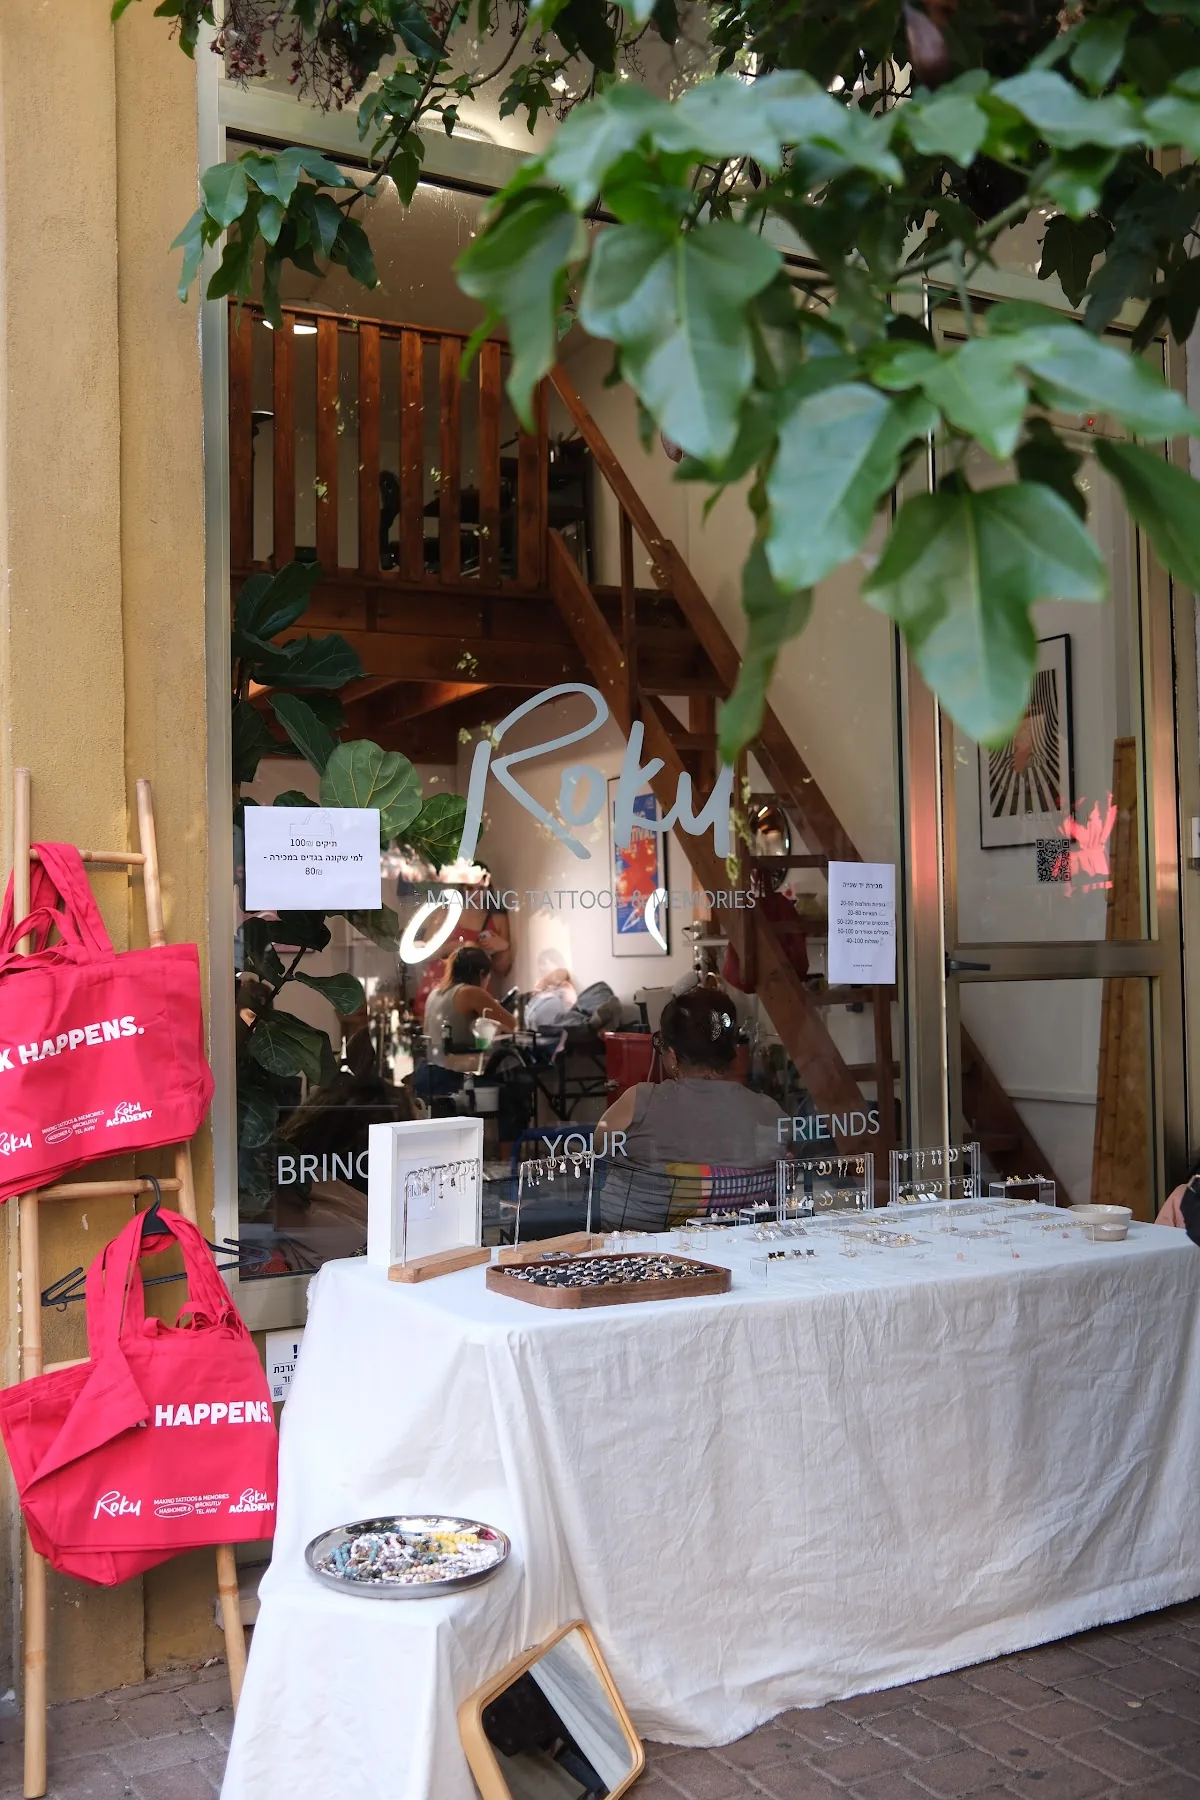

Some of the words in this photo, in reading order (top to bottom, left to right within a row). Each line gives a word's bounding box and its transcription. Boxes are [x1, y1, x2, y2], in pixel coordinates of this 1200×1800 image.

[457, 682, 734, 862] Roku
[315, 840, 337, 849] תיקים
[270, 854, 298, 862] במכירה
[301, 854, 323, 862] בגדים
[325, 854, 348, 864] שקונה
[350, 853, 363, 862] למי
[427, 889, 519, 910] MAKING
[526, 889, 625, 909] TATTOOS
[632, 889, 646, 909] &
[653, 889, 756, 909] MEMORIES
[18, 1015, 144, 1065] HAPPENS.
[106, 1110, 153, 1127] ACADEMY
[542, 1130, 628, 1167] YOUR
[777, 1109, 880, 1143] FRIENDS
[155, 1401, 272, 1427] HAPPENS.
[93, 1490, 141, 1520] Roku
[203, 1493, 230, 1501] MEMORIES
[240, 1488, 267, 1506] Roku
[229, 1502, 274, 1513] ACADEMY
